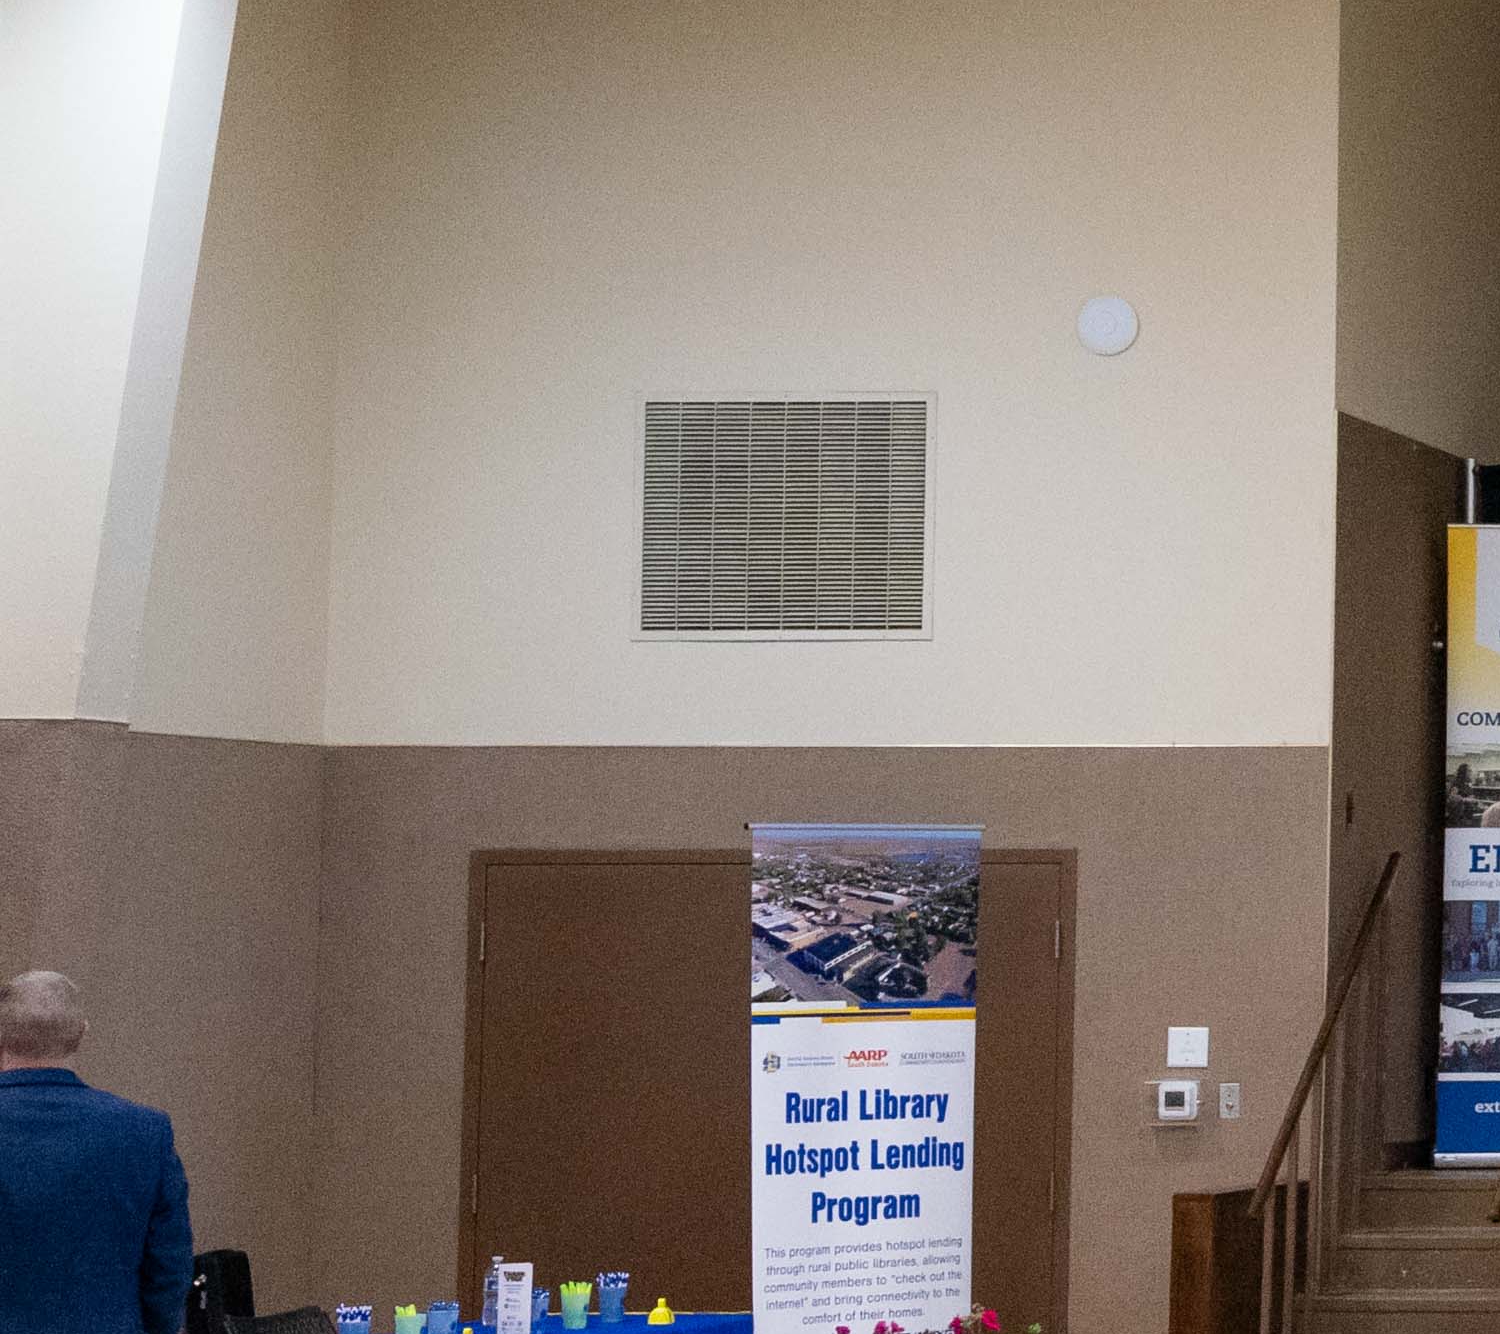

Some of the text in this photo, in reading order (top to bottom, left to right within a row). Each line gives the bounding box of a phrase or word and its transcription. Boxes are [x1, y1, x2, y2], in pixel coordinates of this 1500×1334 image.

[844, 1049, 888, 1061] AARP
[785, 1088, 949, 1123] Rural Library
[765, 1136, 965, 1178] Hotspot Lending
[812, 1191, 921, 1226] Program
[765, 1236, 963, 1259] This program provides hotspot lending
[766, 1254, 960, 1276] through rural public libraries, allowing
[764, 1280, 818, 1293] community
[821, 1277, 872, 1289] members
[876, 1276, 887, 1285] to
[930, 1272, 945, 1281] out
[948, 1270, 962, 1280] the
[811, 1296, 831, 1307] and
[834, 1294, 863, 1307] bring
[866, 1289, 930, 1303] connectivity
[933, 1288, 942, 1298] to
[946, 1287, 960, 1297] the
[802, 1307, 925, 1325] comfort of their homes.
